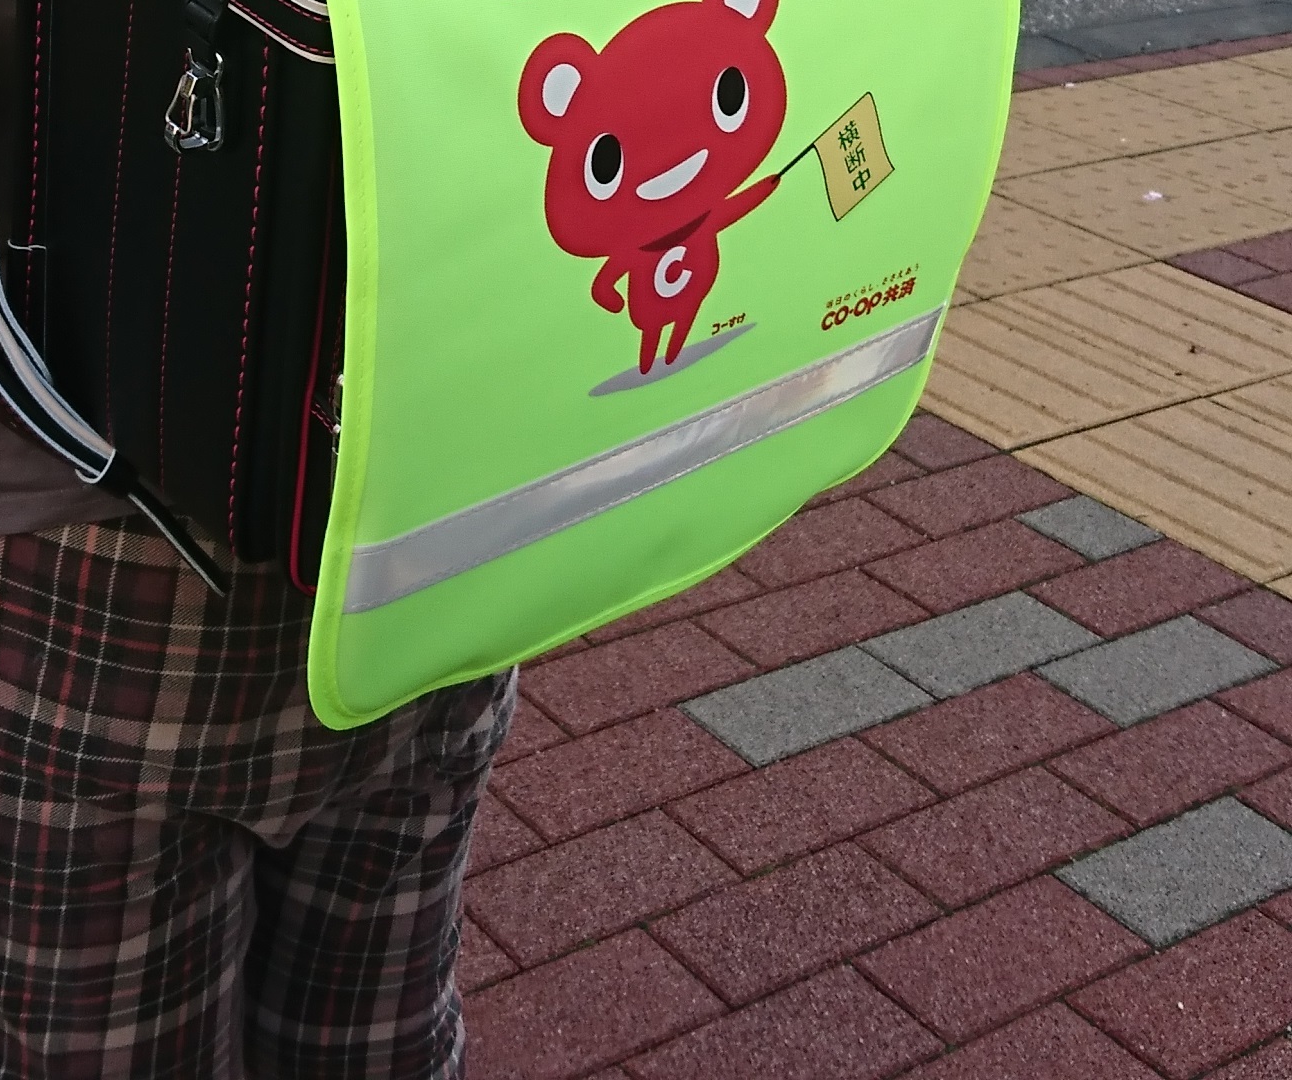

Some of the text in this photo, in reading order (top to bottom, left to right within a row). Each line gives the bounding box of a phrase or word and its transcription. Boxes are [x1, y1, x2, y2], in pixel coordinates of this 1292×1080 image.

[838, 120, 871, 192] 横断中
[654, 246, 692, 298] C
[711, 312, 746, 336] コーすけ
